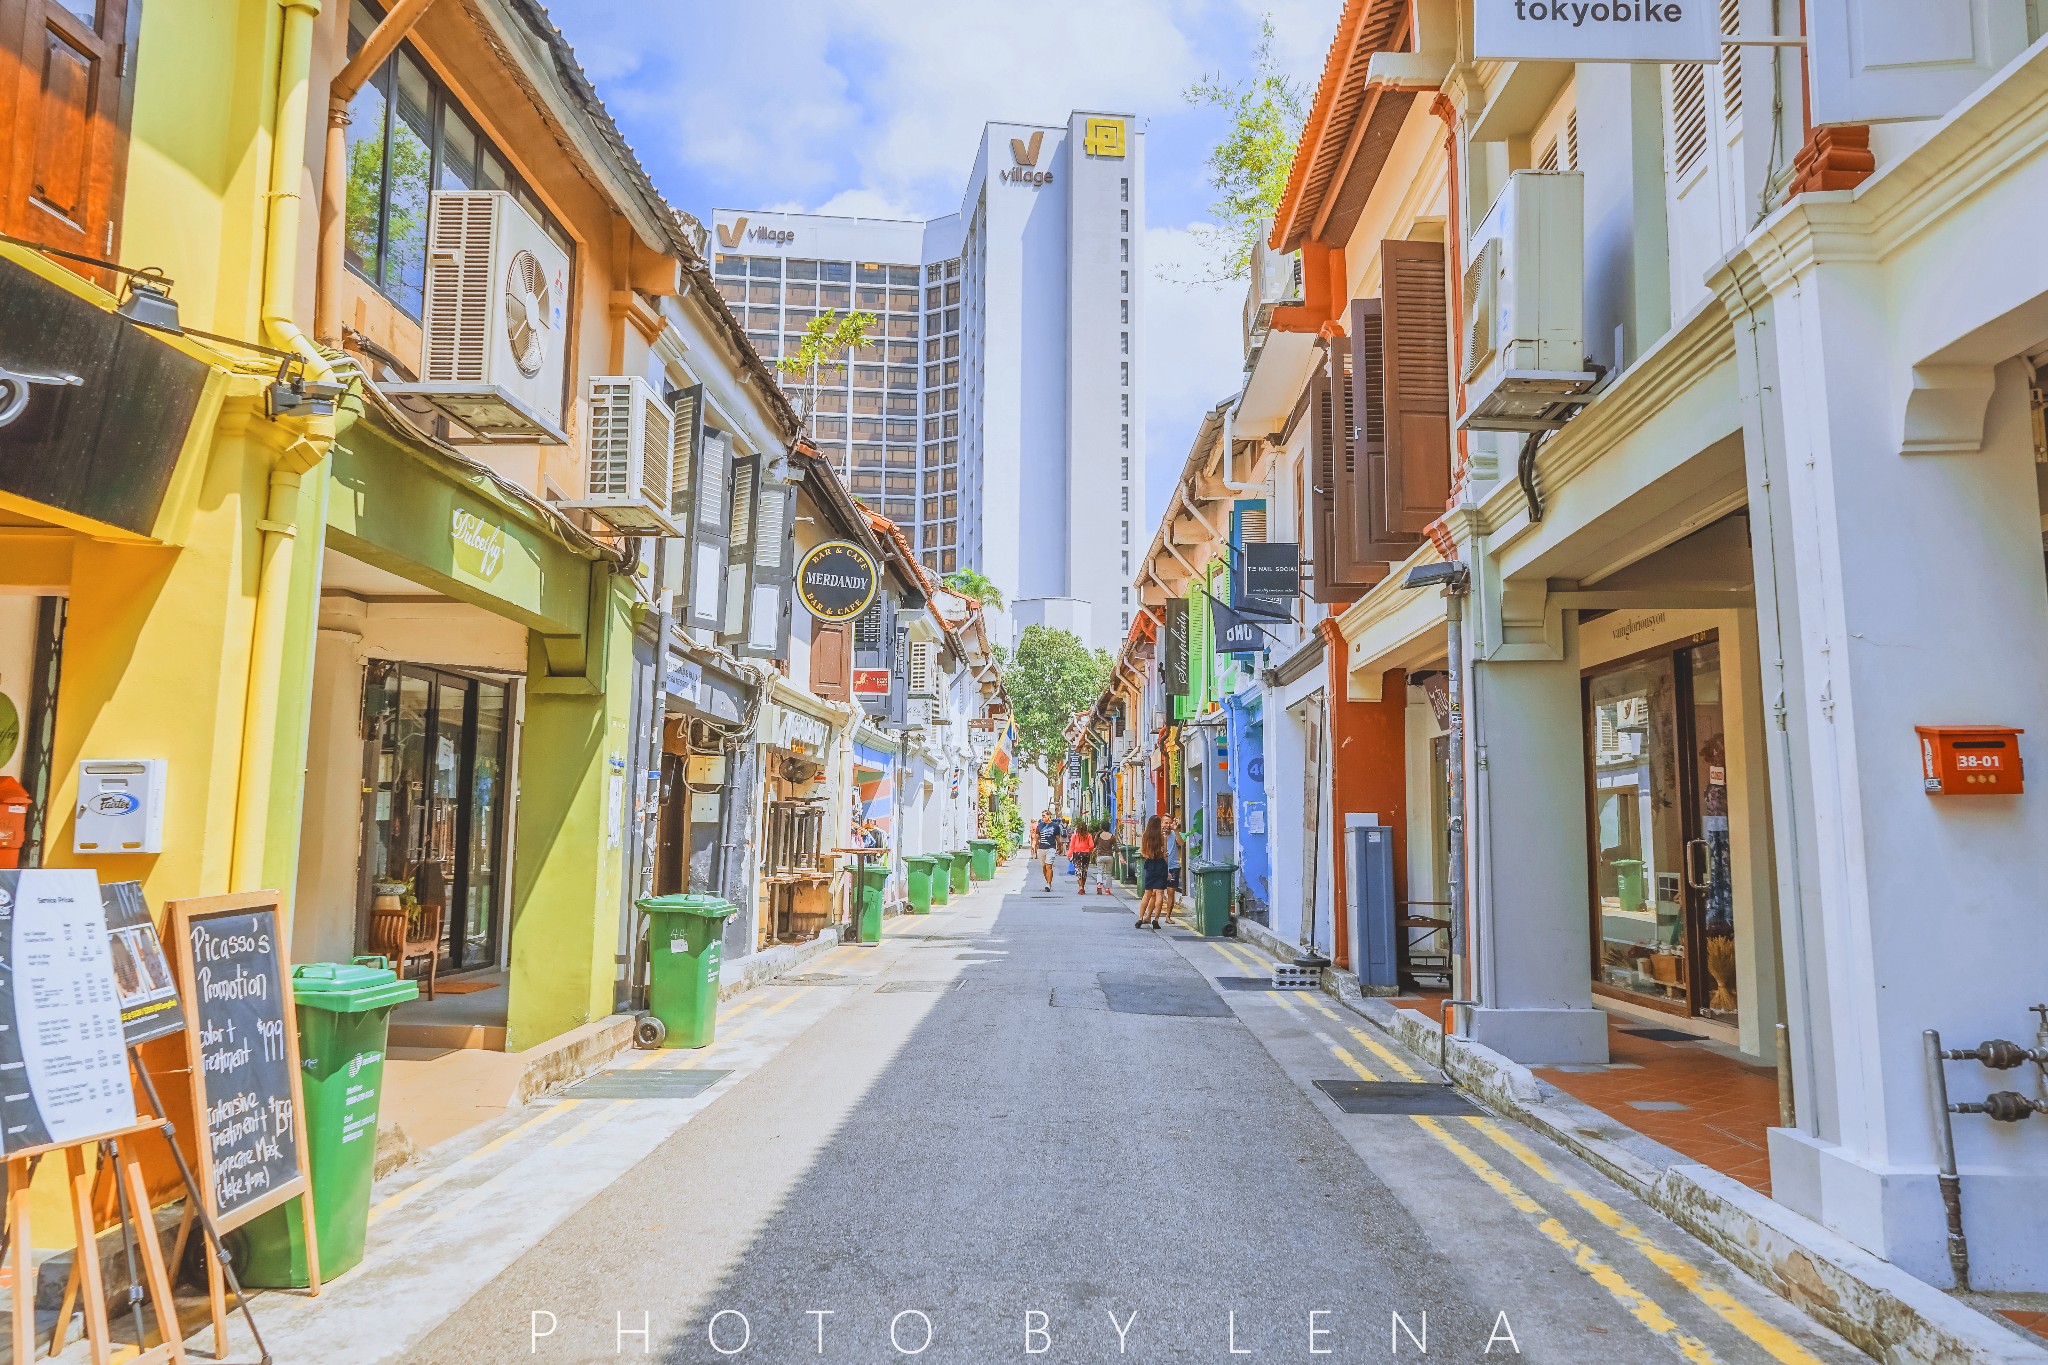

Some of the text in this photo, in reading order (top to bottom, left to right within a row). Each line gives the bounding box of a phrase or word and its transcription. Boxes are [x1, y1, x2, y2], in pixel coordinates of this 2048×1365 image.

[1515, 0, 1682, 27] tokyobike
[1000, 167, 1054, 187] village
[748, 226, 795, 244] village
[812, 548, 831, 564] BAR
[805, 572, 869, 590] MERDANDY
[807, 592, 824, 611] BAR
[826, 607, 833, 615] &
[1170, 610, 1190, 684] Simplicity
[1958, 755, 2000, 767] 38-01
[190, 918, 270, 962] Picasso's
[197, 964, 267, 1003] Promotion
[256, 1017, 284, 1063] $199
[201, 1037, 252, 1076] Treatment
[206, 1091, 260, 1128] Intensive
